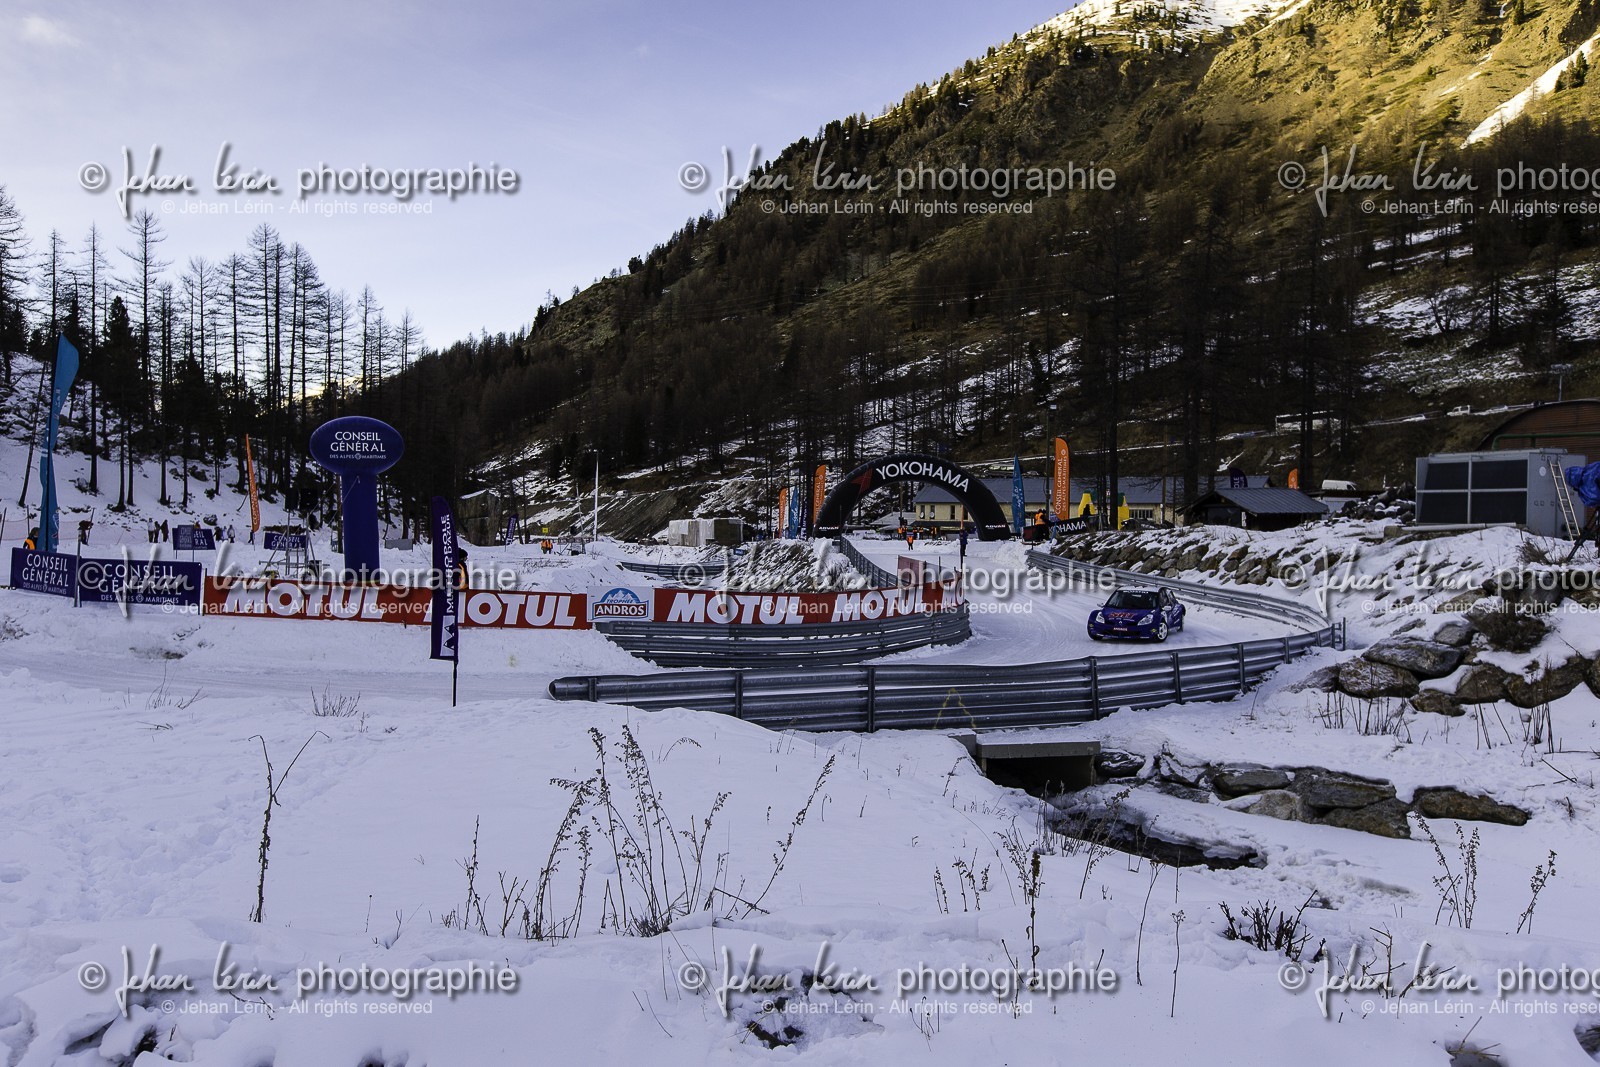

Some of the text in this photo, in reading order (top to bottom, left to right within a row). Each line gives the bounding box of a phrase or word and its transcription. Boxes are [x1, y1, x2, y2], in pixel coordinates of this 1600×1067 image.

[335, 432, 380, 440] CONSEIL
[330, 440, 386, 452] GÉNÉRAL
[876, 461, 970, 493] YOKOHAMA
[27, 554, 68, 571] CONSEIL
[103, 564, 176, 579] CONSEIL
[22, 567, 68, 586] GÉNÉRAL
[223, 582, 385, 619] MOTUL
[666, 593, 805, 625] MOTUL
[830, 586, 926, 623] MOTUL
[596, 605, 644, 615] ANDROS
